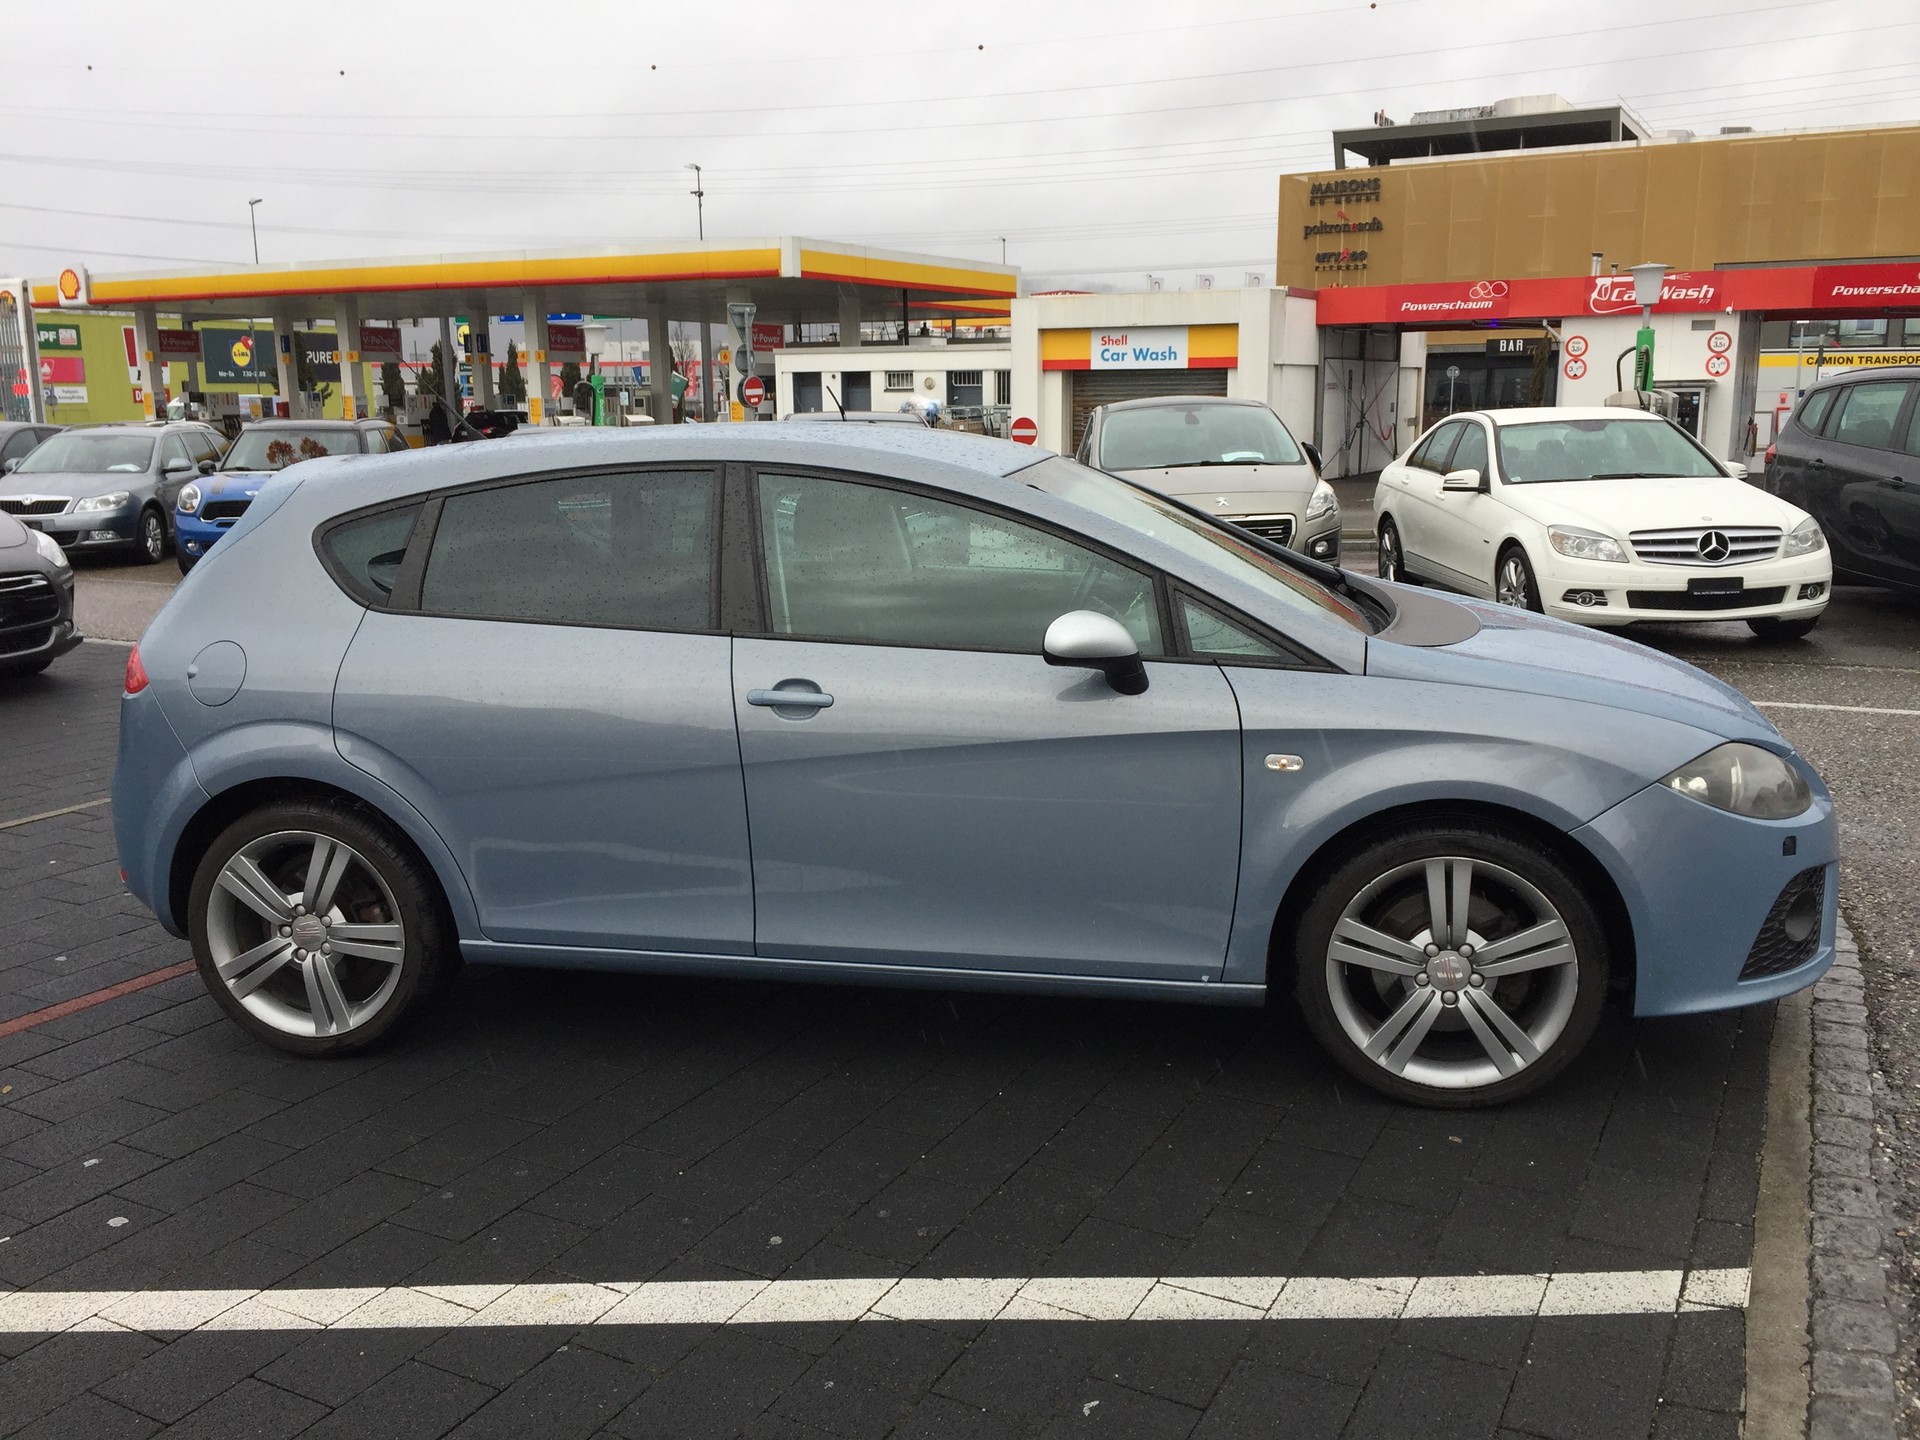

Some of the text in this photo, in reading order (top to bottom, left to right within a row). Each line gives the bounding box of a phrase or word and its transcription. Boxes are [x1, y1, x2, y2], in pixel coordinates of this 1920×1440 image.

[1310, 177, 1381, 195] MAISONS
[1401, 300, 1493, 312] Powerschaum
[1101, 335, 1128, 346] Shell
[1500, 339, 1523, 352] BAR
[1100, 346, 1178, 362] Car Wash
